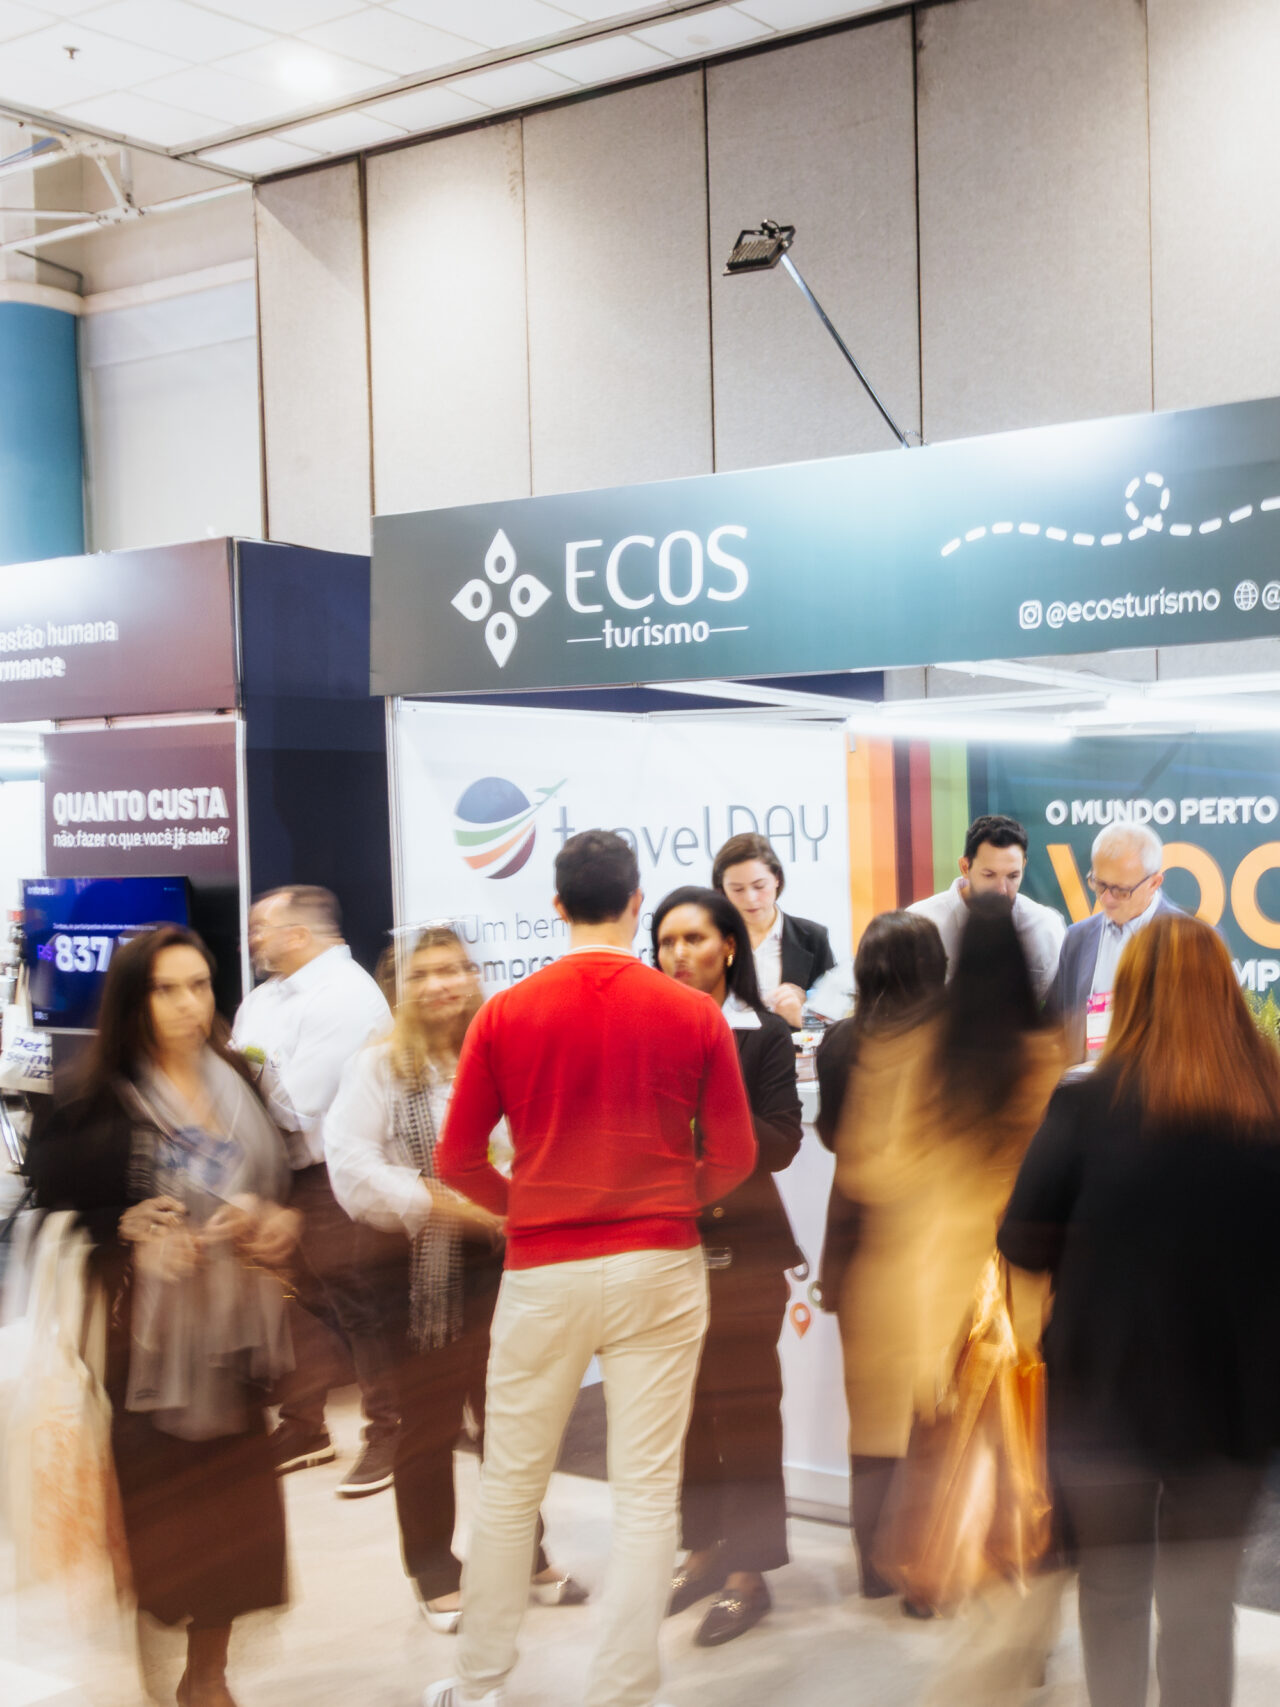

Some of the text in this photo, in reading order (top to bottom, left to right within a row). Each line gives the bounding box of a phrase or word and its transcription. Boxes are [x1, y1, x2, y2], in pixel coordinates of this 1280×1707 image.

[565, 525, 749, 614] ECOS
[1046, 586, 1221, 629] @ecosturismo
[47, 620, 119, 648] humana
[602, 616, 710, 649] turismo
[53, 786, 229, 826] QUANTO CUSTA
[1045, 800, 1069, 826] O
[1071, 799, 1177, 826] MUNDO
[1180, 796, 1279, 825] PERTO
[53, 830, 74, 848] não
[75, 830, 106, 848] fazer
[108, 833, 117, 846] o
[118, 831, 142, 850] que
[143, 828, 171, 846] você
[187, 826, 230, 846] sabe?
